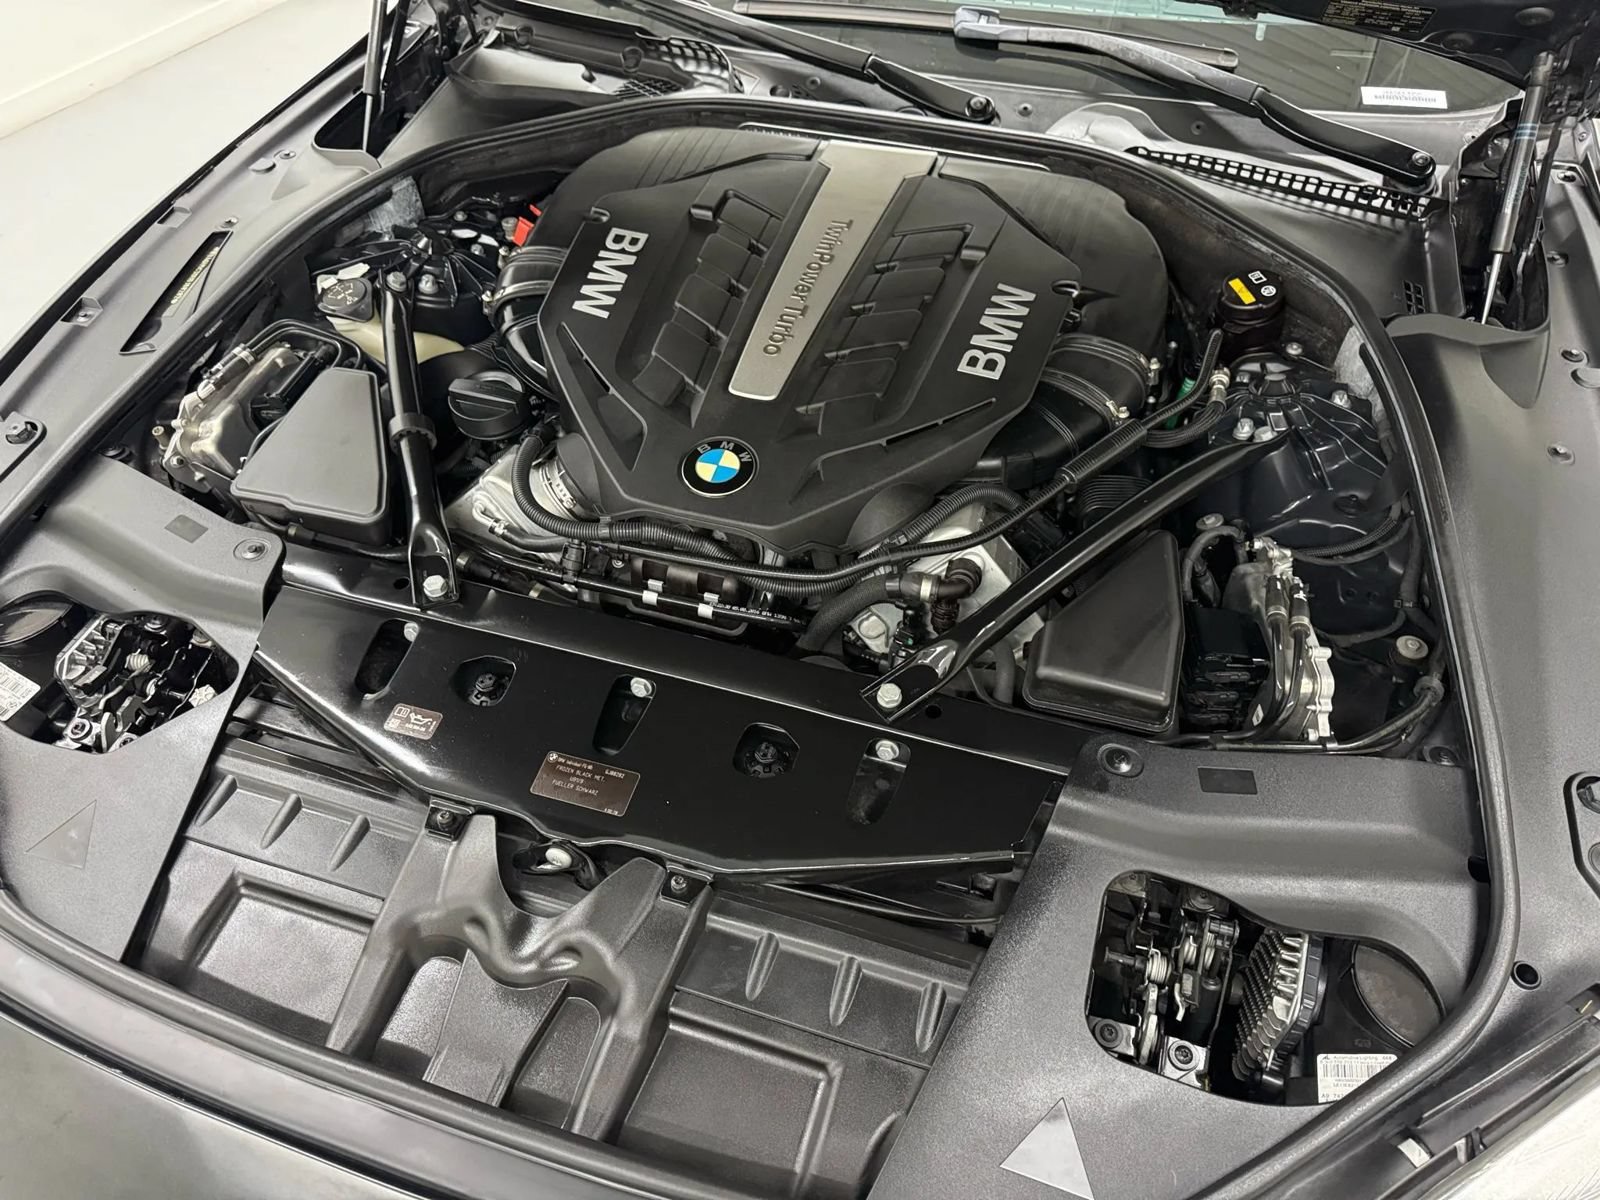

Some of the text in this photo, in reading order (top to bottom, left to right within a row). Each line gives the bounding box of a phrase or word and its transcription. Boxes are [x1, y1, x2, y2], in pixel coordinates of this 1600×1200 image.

[572, 227, 649, 319] BMW
[763, 219, 853, 358] TwinPower Turbo
[957, 283, 1037, 380] BMW
[697, 441, 752, 462] BMW
[556, 765, 574, 774] FROZEN
[575, 770, 593, 779] BLACK
[575, 785, 599, 796] SCHWARZ
